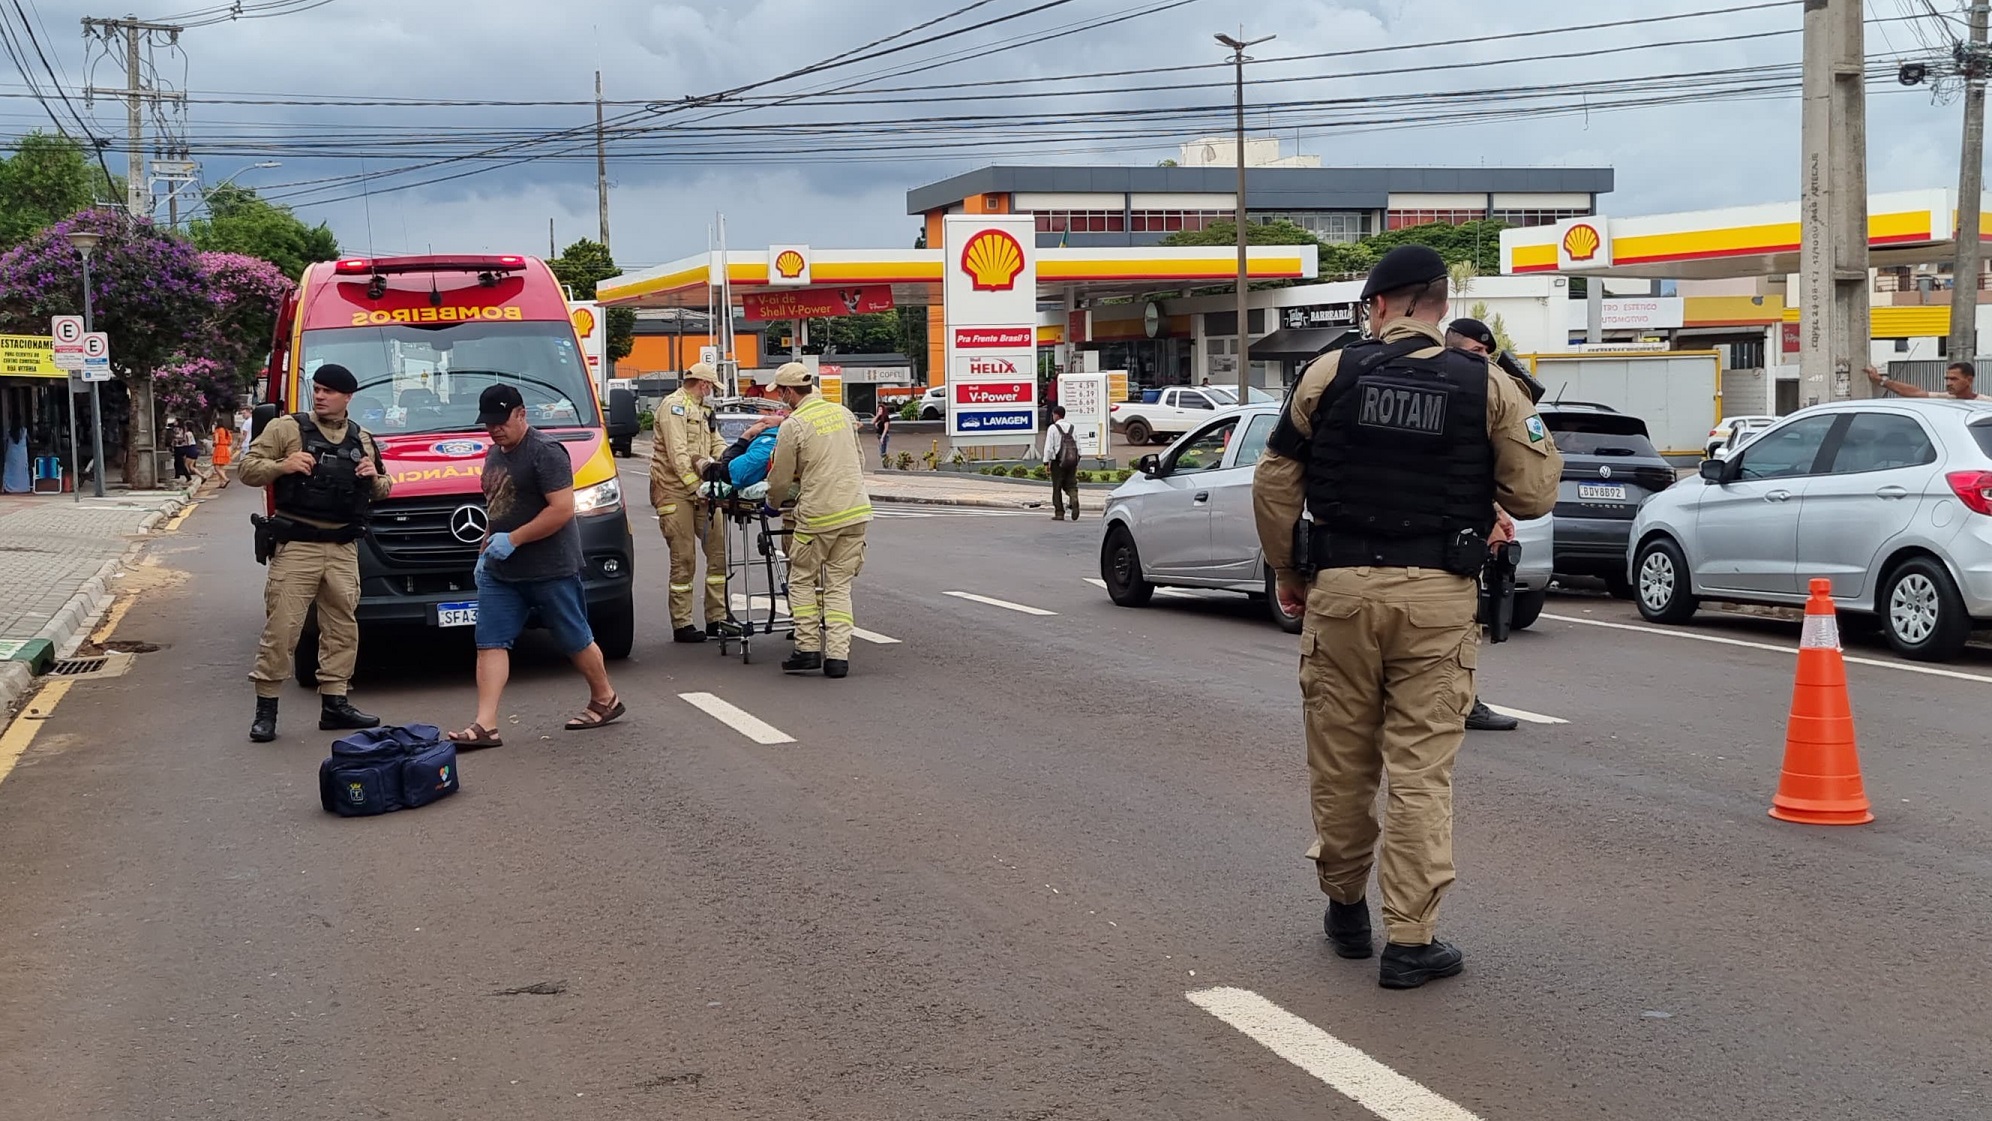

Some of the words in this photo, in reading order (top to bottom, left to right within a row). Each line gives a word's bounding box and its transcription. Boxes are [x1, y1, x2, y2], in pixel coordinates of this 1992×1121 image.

[782, 293, 796, 304] de
[760, 306, 785, 317] Shell
[788, 305, 832, 316] V-Power
[1310, 309, 1353, 322] BARBEARIA
[64, 324, 72, 338] E
[1, 339, 53, 350] ESTACIONAME
[90, 340, 97, 352] E
[705, 355, 711, 363] E
[970, 363, 1016, 374] HELIX
[969, 392, 1018, 402] V-Power
[1362, 386, 1442, 430] ROTAM
[983, 416, 1028, 425] LAVAGEM
[445, 610, 478, 624] SFA3
